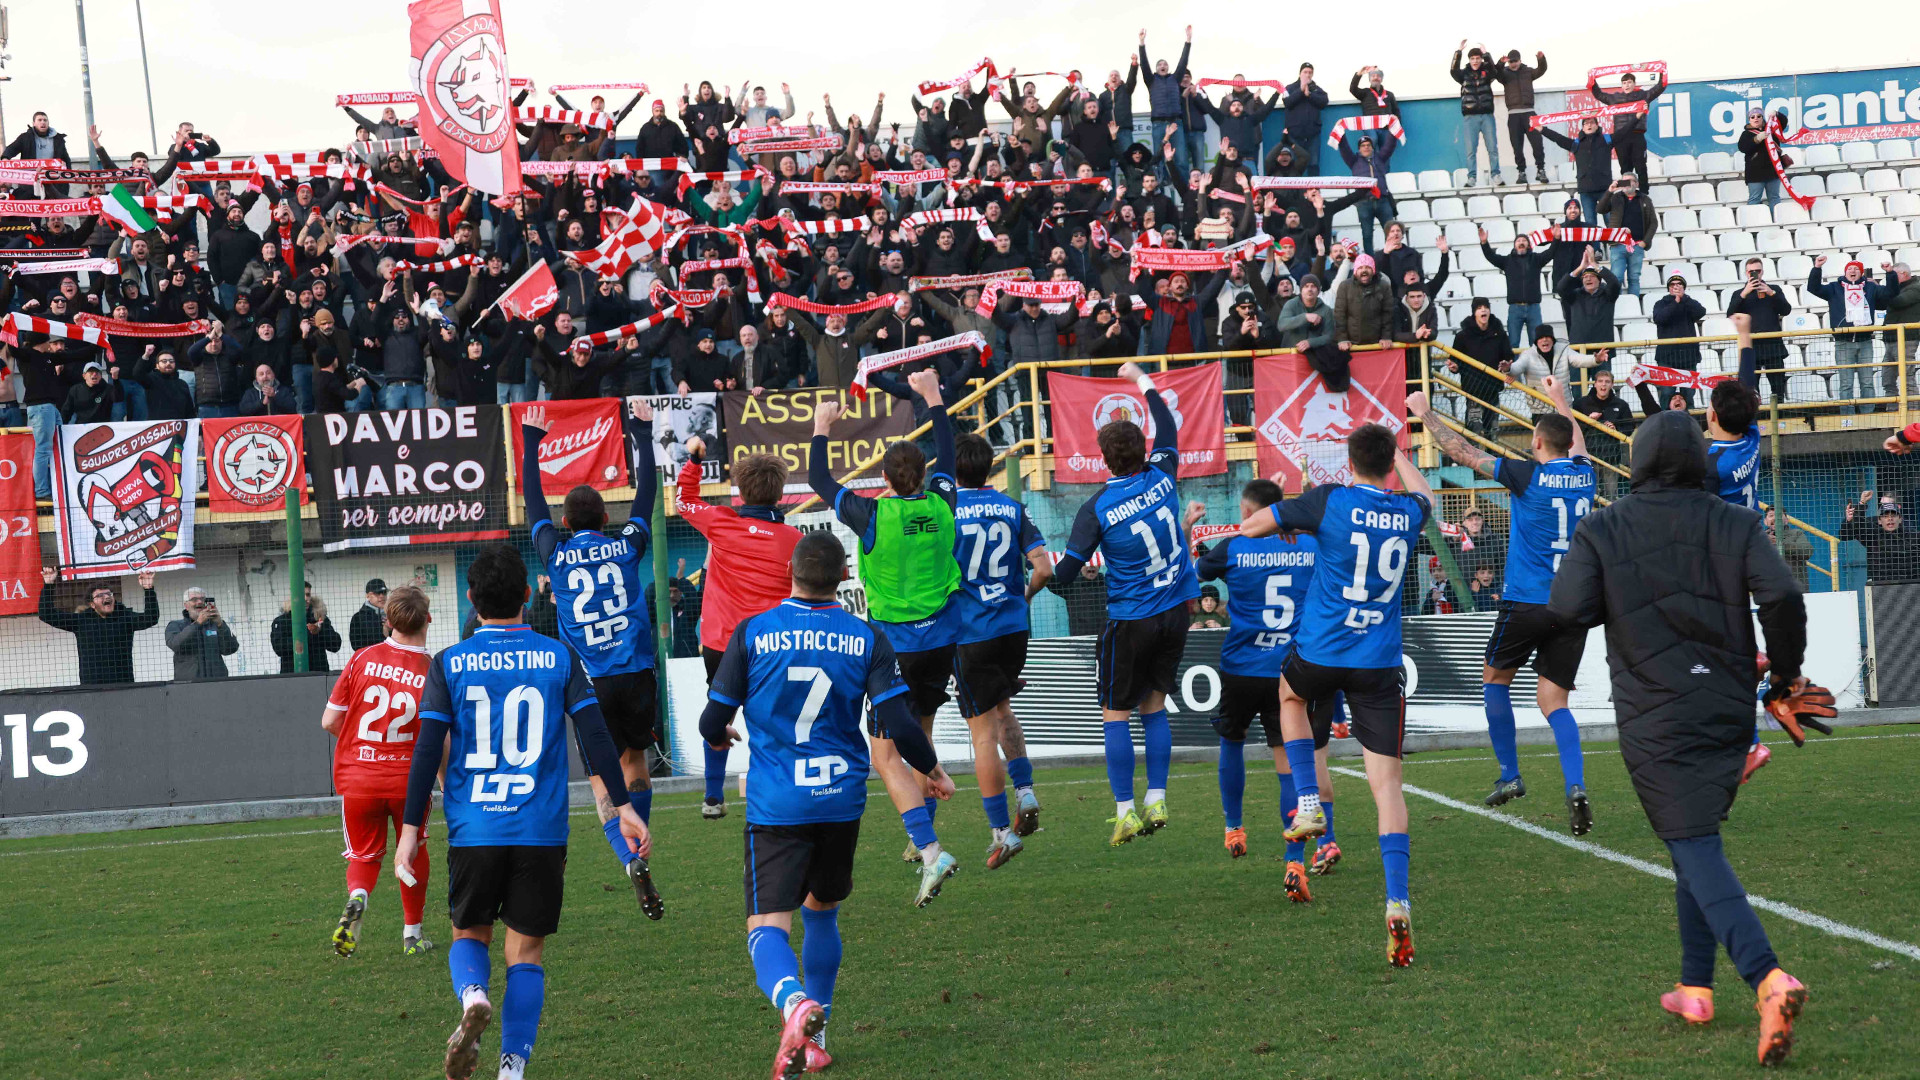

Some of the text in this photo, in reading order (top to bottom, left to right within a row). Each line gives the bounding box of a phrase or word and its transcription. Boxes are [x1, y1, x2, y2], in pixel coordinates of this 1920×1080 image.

[1657, 92, 1692, 139] il
[904, 172, 928, 182] CALCIO
[929, 169, 945, 179] 1919
[1042, 283, 1053, 294] SI
[229, 423, 280, 439] RAGAZZI
[324, 405, 477, 446] DAVIDE
[81, 420, 183, 471] SQUADRE D'ASSALTO
[397, 444, 410, 459] e
[116, 477, 143, 499] CURVA
[121, 488, 143, 506] NORD
[231, 485, 287, 505] DELLA NORD
[1106, 477, 1174, 526] BIANCHETTI
[388, 499, 485, 531] sempre
[955, 503, 1016, 520] AMPAGNA
[1351, 507, 1410, 532] CABRI
[1130, 505, 1183, 576] 11
[1194, 523, 1236, 538] FORZA
[555, 539, 628, 566] POLEDRI
[961, 520, 1012, 581] 72
[1236, 551, 1315, 568] TAUGOURDEAU
[1343, 531, 1408, 604] 19
[1, 580, 29, 601] IA
[567, 561, 628, 623] 23
[1262, 574, 1295, 630] 5
[584, 615, 629, 647] LTP
[1344, 606, 1385, 629] LTP
[755, 629, 865, 657] MUSTACCHIO
[1254, 632, 1292, 648] LTP
[364, 661, 426, 689] RIBERO
[450, 651, 556, 674] D'AGOSTINO
[357, 684, 417, 743] 22
[787, 666, 833, 745] 7
[464, 684, 545, 769] 10
[0, 710, 89, 779] 13
[795, 755, 849, 787] LTP
[470, 774, 535, 803] LTP
[482, 804, 518, 812] Fuel&Rent
